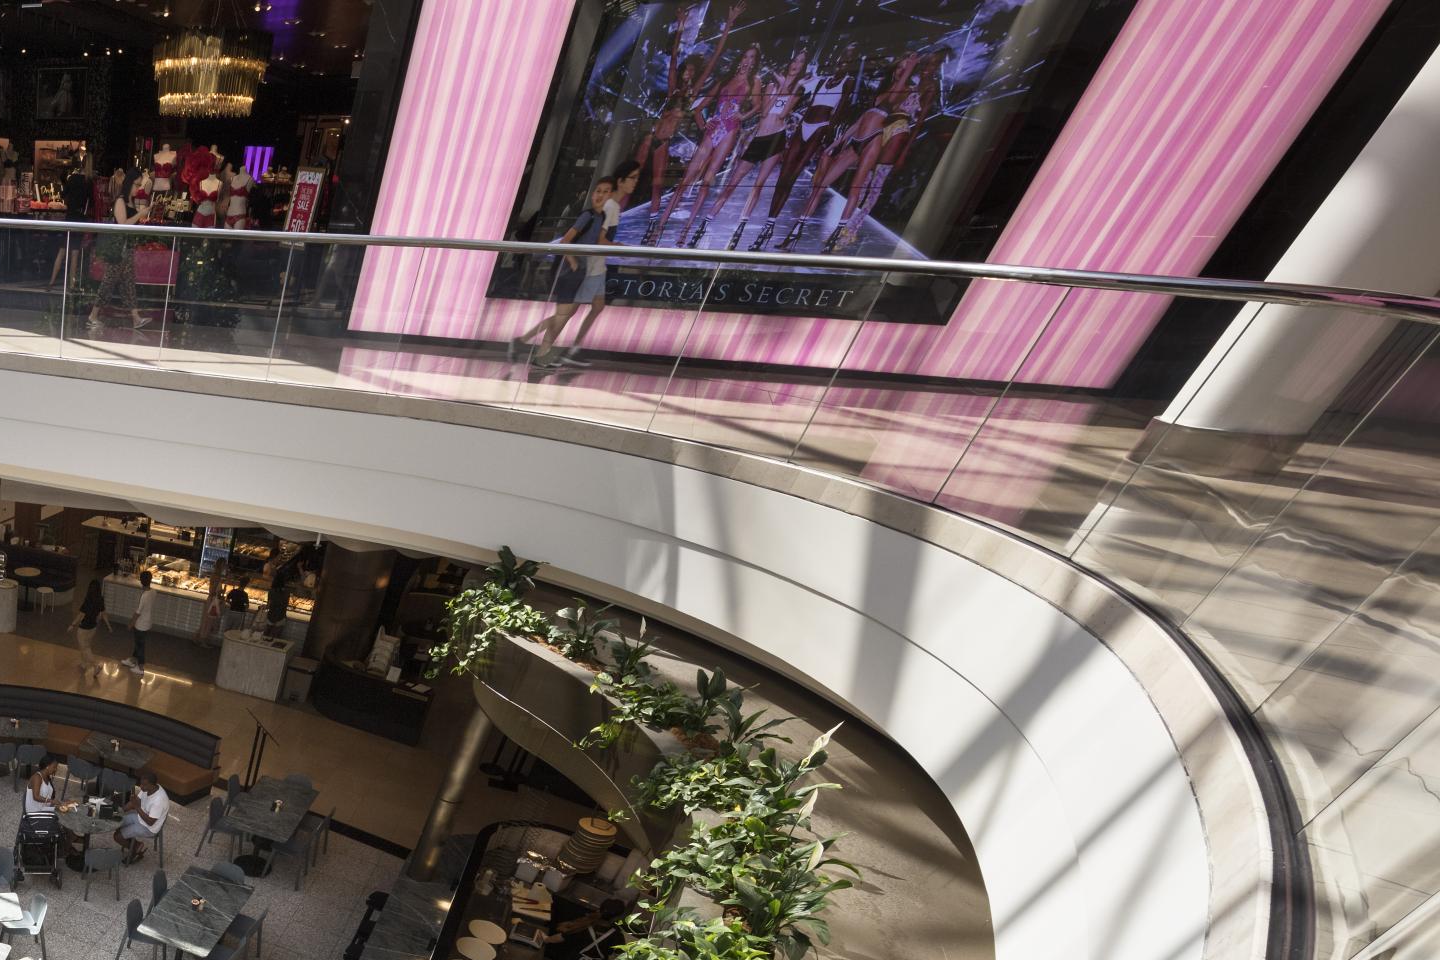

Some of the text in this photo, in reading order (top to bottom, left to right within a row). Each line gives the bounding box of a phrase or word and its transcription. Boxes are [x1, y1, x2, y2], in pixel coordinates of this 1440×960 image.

[297, 200, 309, 210] SALE
[605, 278, 854, 307] CTORIA'S SECRET
